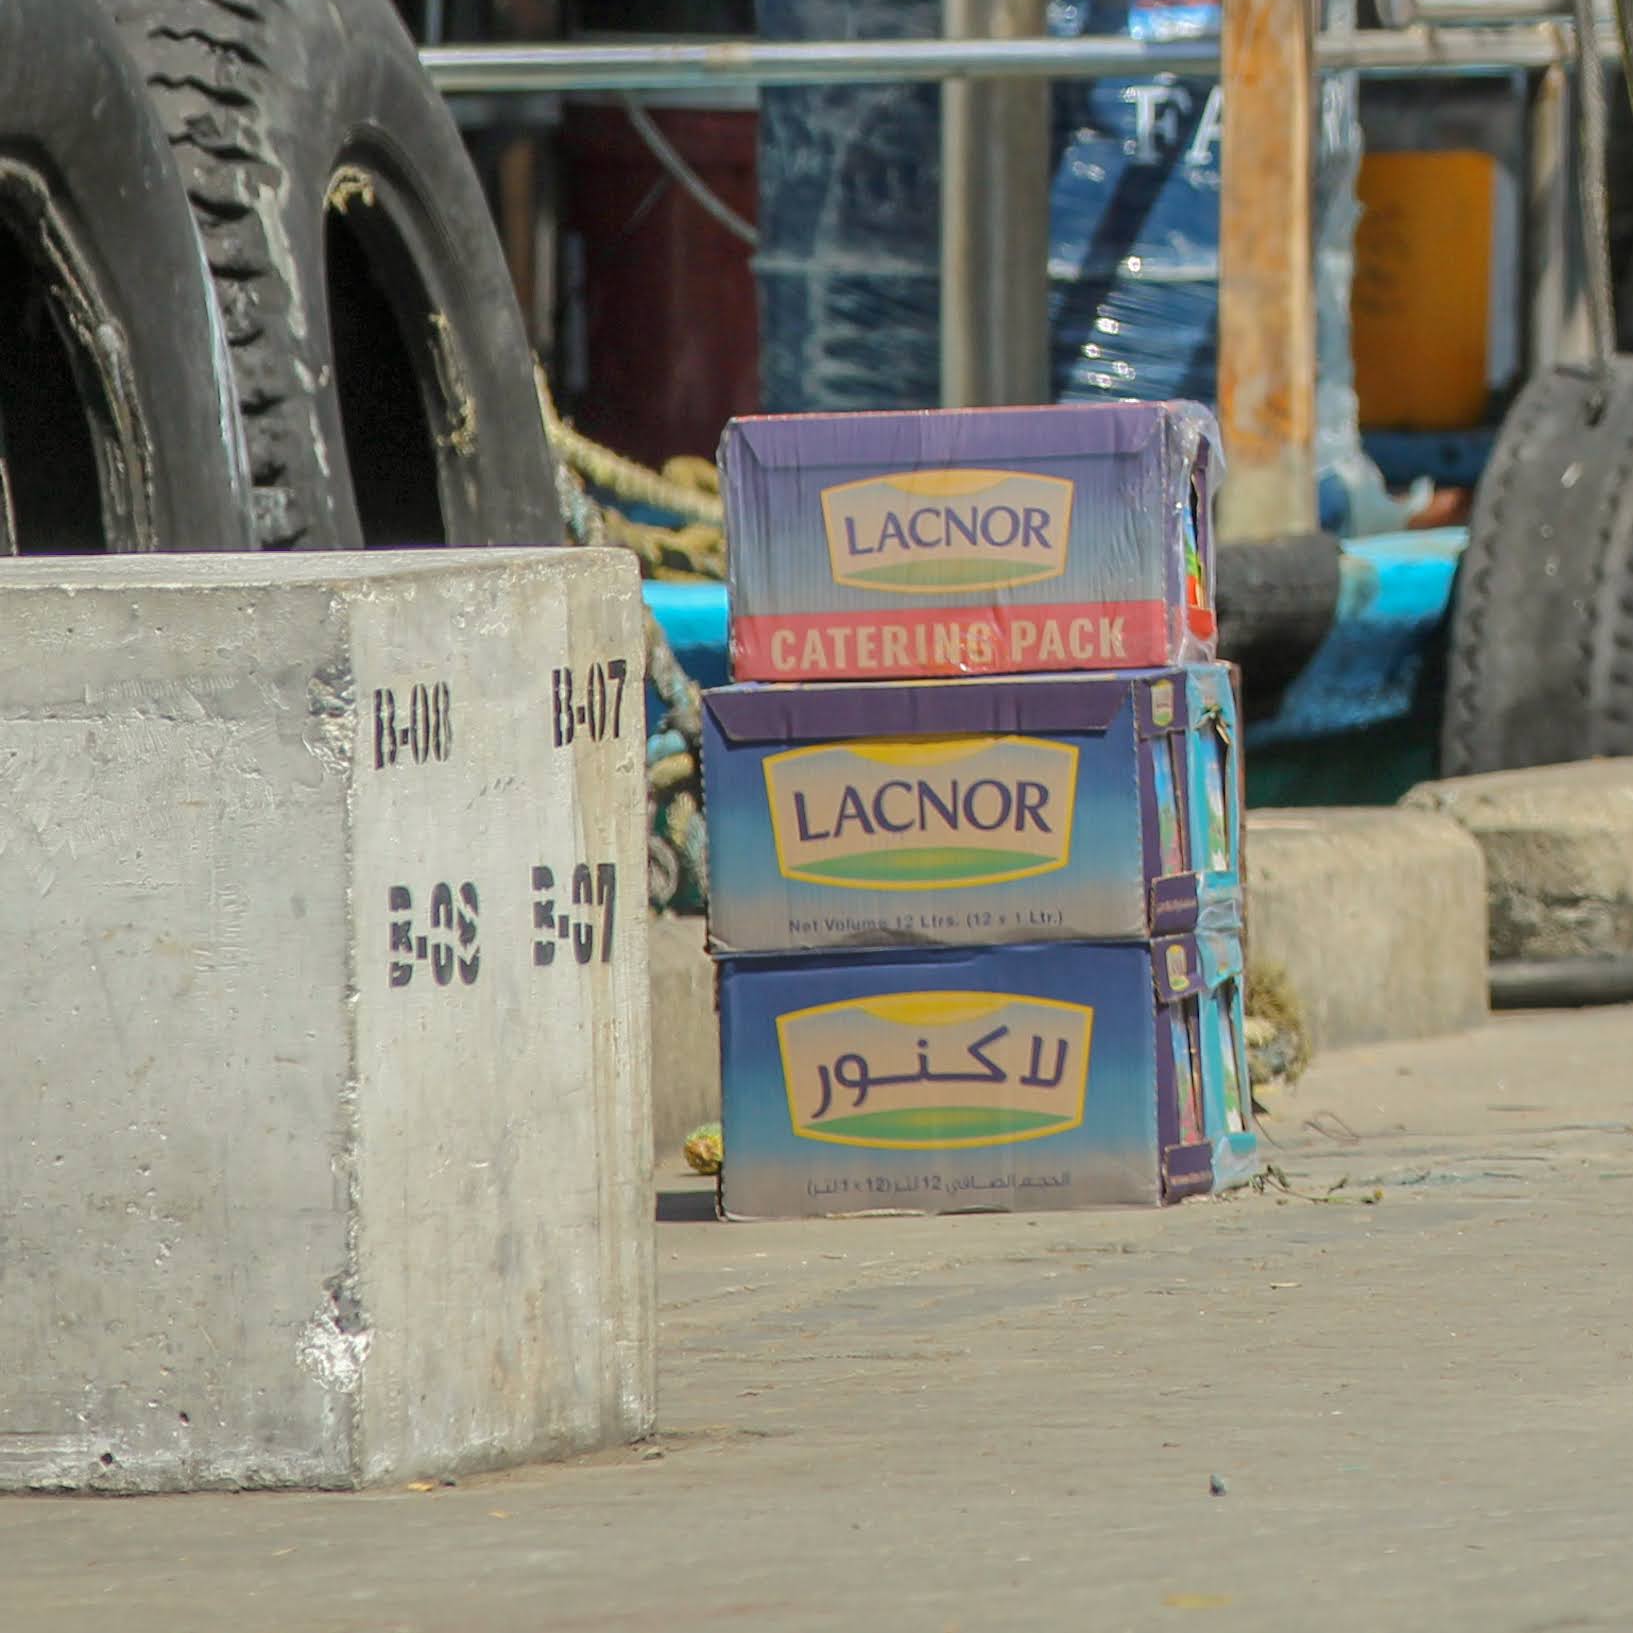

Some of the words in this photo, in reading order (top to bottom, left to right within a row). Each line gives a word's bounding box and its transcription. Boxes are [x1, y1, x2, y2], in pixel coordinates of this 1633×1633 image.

[844, 504, 1054, 557] LACNOR
[770, 621, 994, 671] CATERING
[1011, 616, 1127, 663] PACK
[793, 779, 1053, 842] LACNOR
[810, 1026, 1070, 1120] لاكنور
